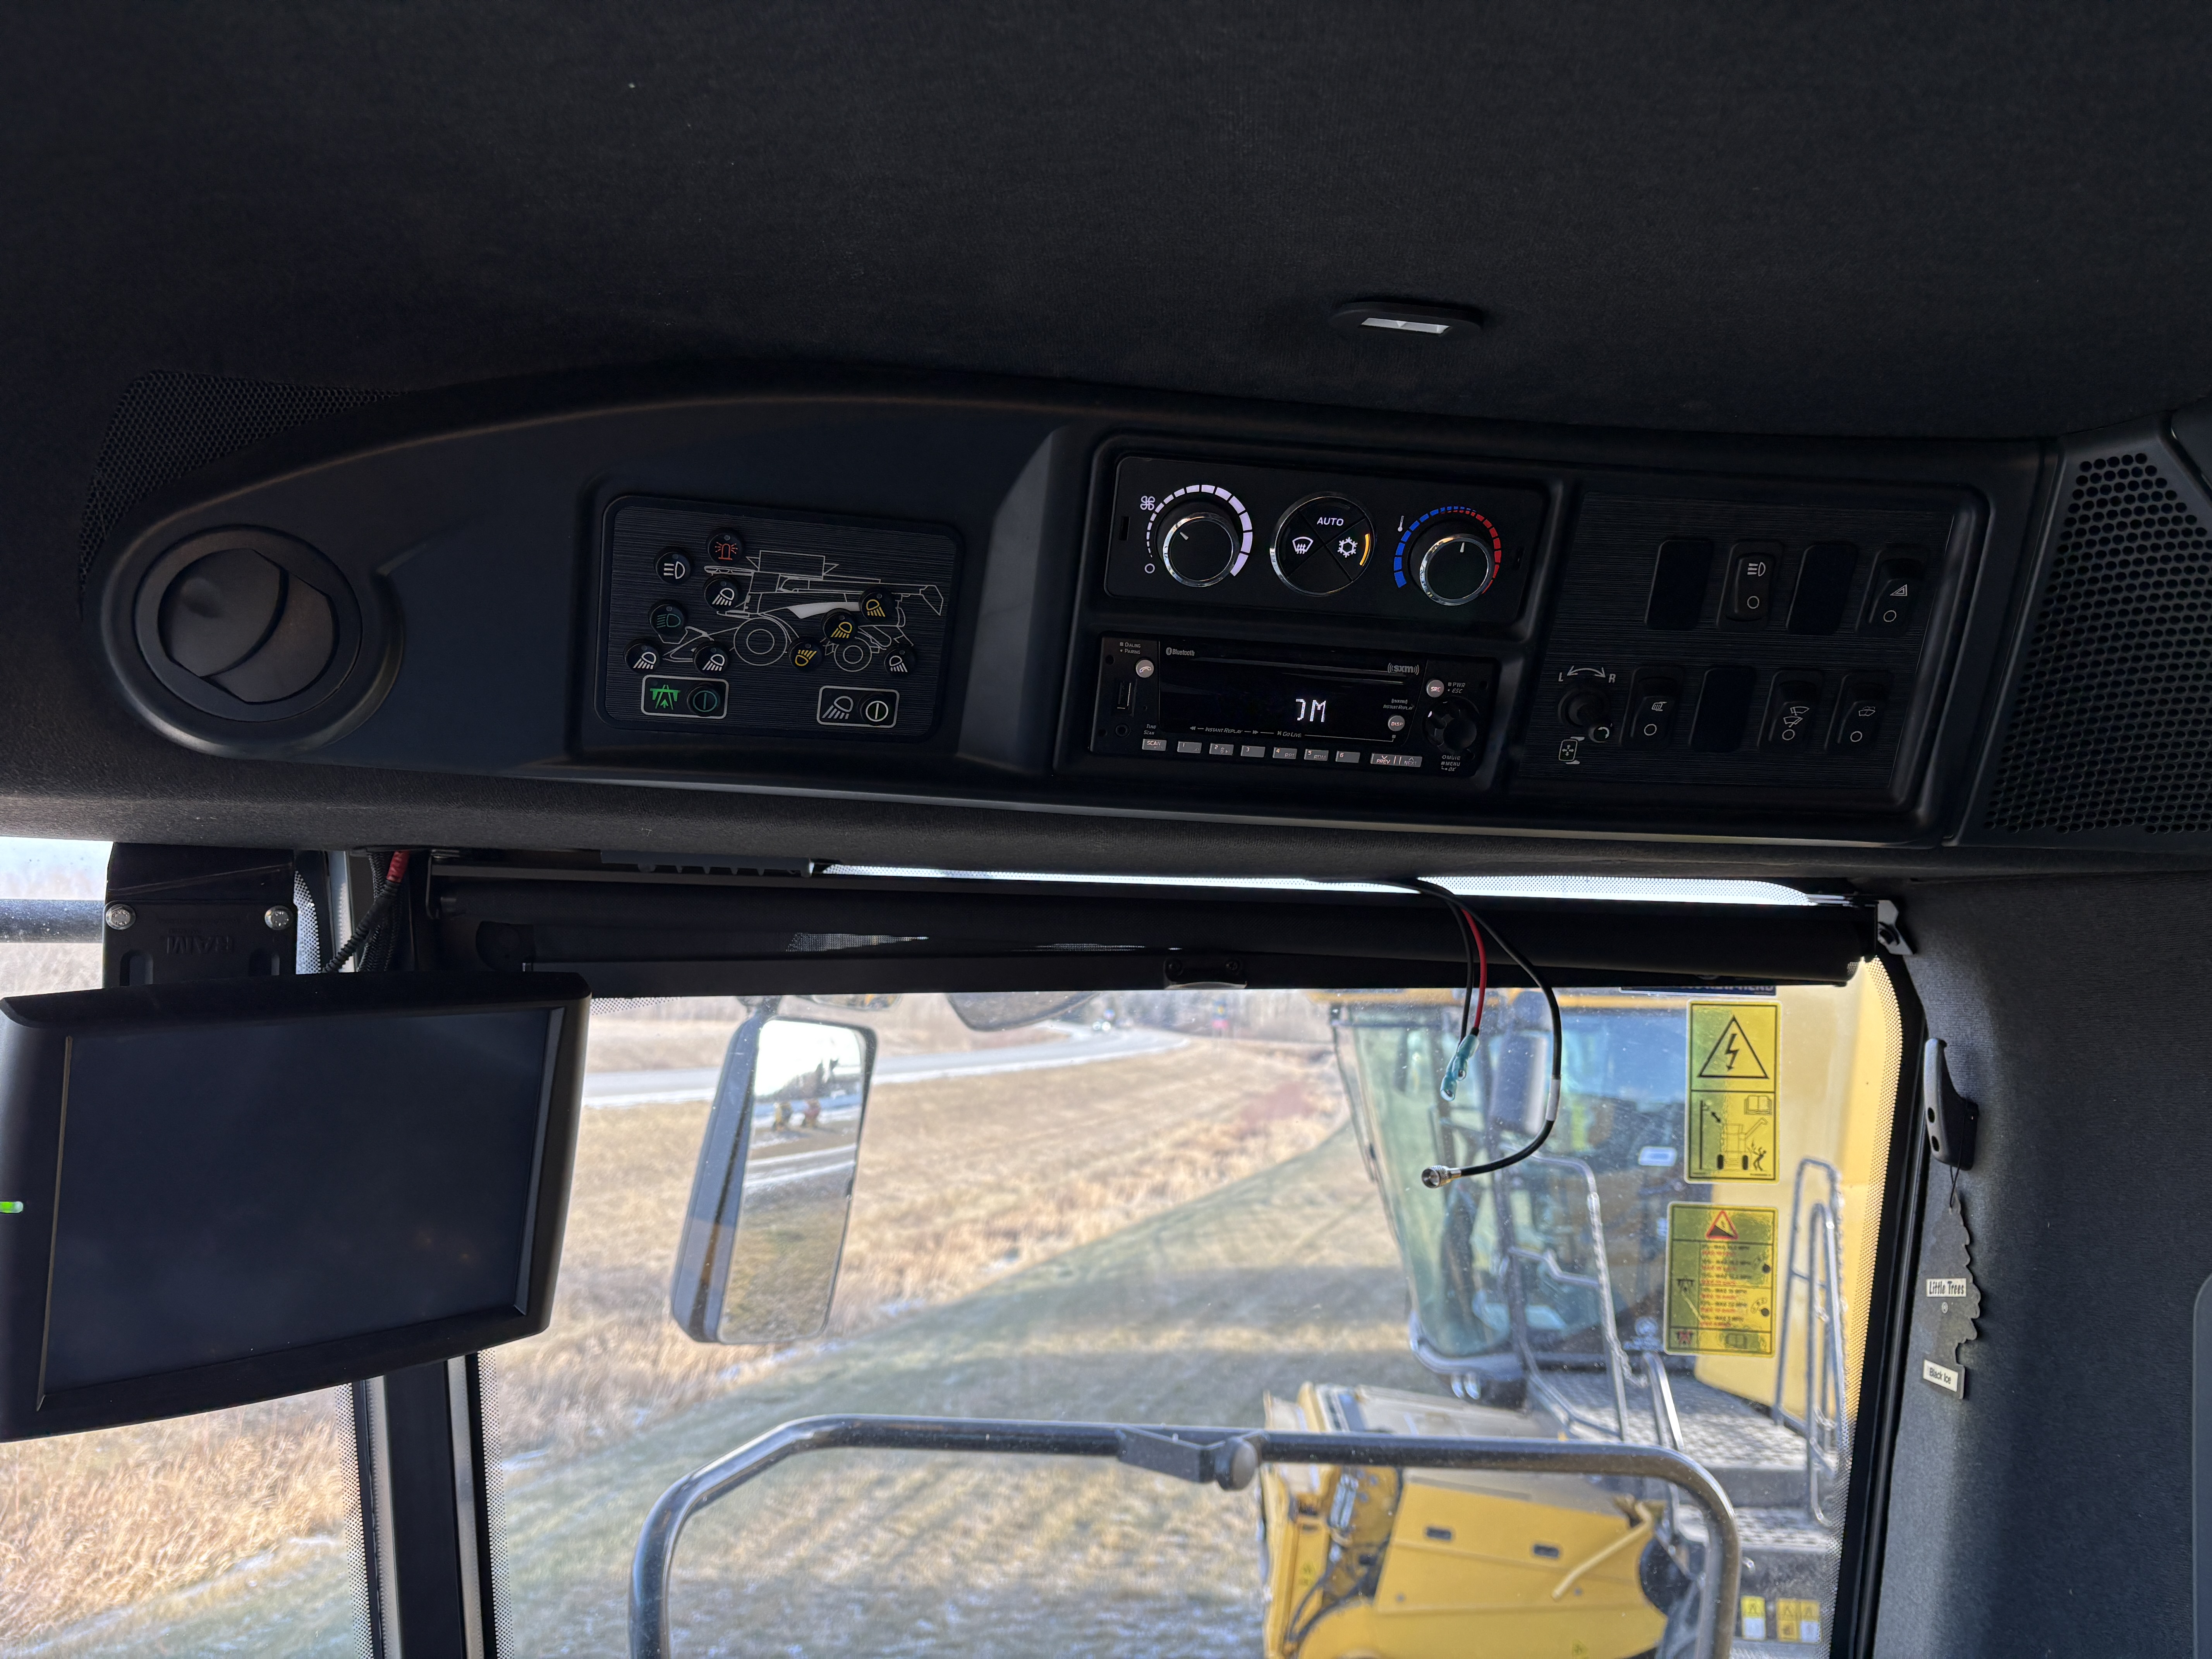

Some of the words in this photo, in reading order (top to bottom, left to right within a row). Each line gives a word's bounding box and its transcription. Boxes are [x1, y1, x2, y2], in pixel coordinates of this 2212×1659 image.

[1317, 517, 1344, 526] AUTO
[1558, 672, 1563, 682] L
[1608, 673, 1616, 683] R
[1929, 1281, 1946, 1295] Little
[1948, 1281, 1964, 1295] Trees
[1929, 1367, 1943, 1380] Black
